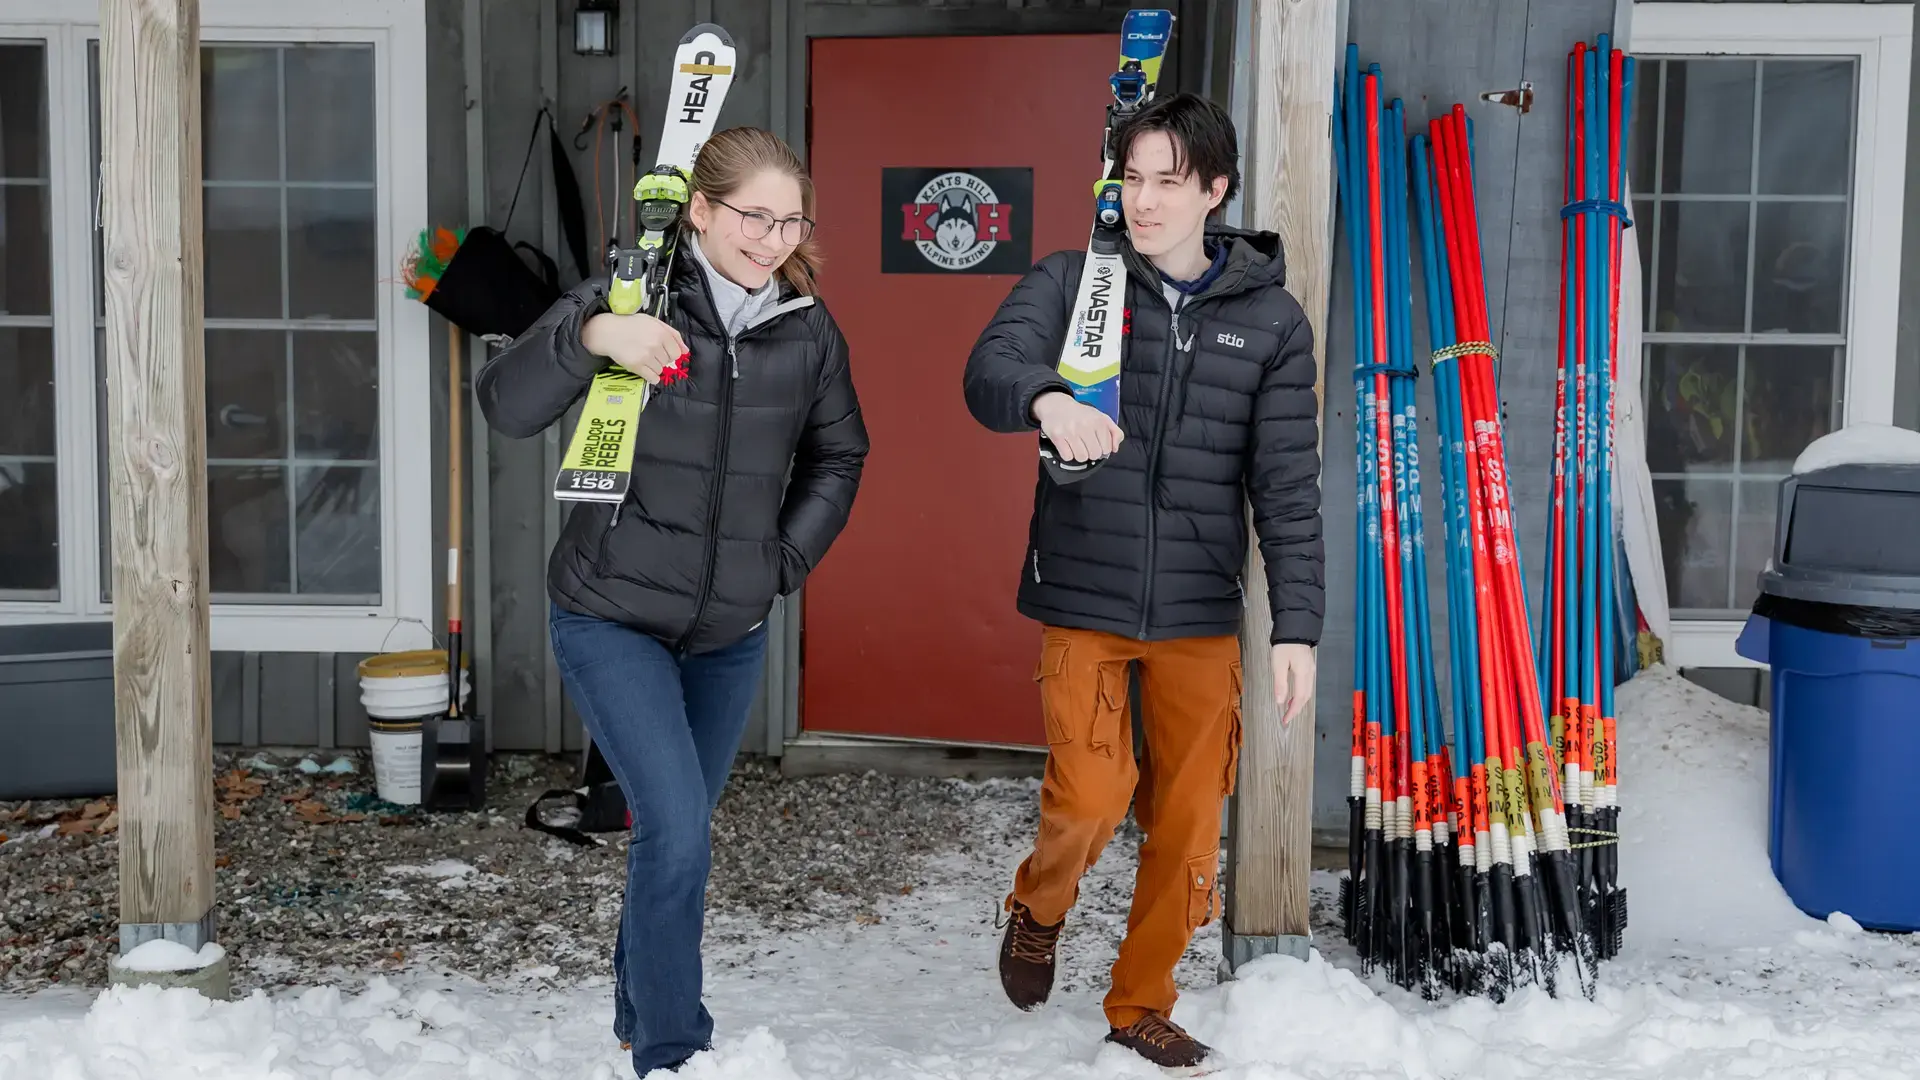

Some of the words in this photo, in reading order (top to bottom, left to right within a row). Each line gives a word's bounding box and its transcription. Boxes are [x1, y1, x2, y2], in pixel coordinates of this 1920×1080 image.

[679, 51, 716, 123] HEAD
[922, 175, 962, 202] KENTS
[966, 178, 992, 202] HILL
[901, 203, 940, 241] K
[976, 203, 1012, 241] H
[921, 243, 955, 266] ALPINE
[958, 243, 991, 266] SKIING
[1080, 266, 1113, 358] YNASTAR
[1217, 333, 1245, 348] stio
[579, 417, 605, 467] WORLDCUP
[595, 419, 627, 468] REBELS
[570, 478, 615, 490] 150
[1407, 443, 1422, 513] SPM
[1594, 741, 1605, 781] SPM
